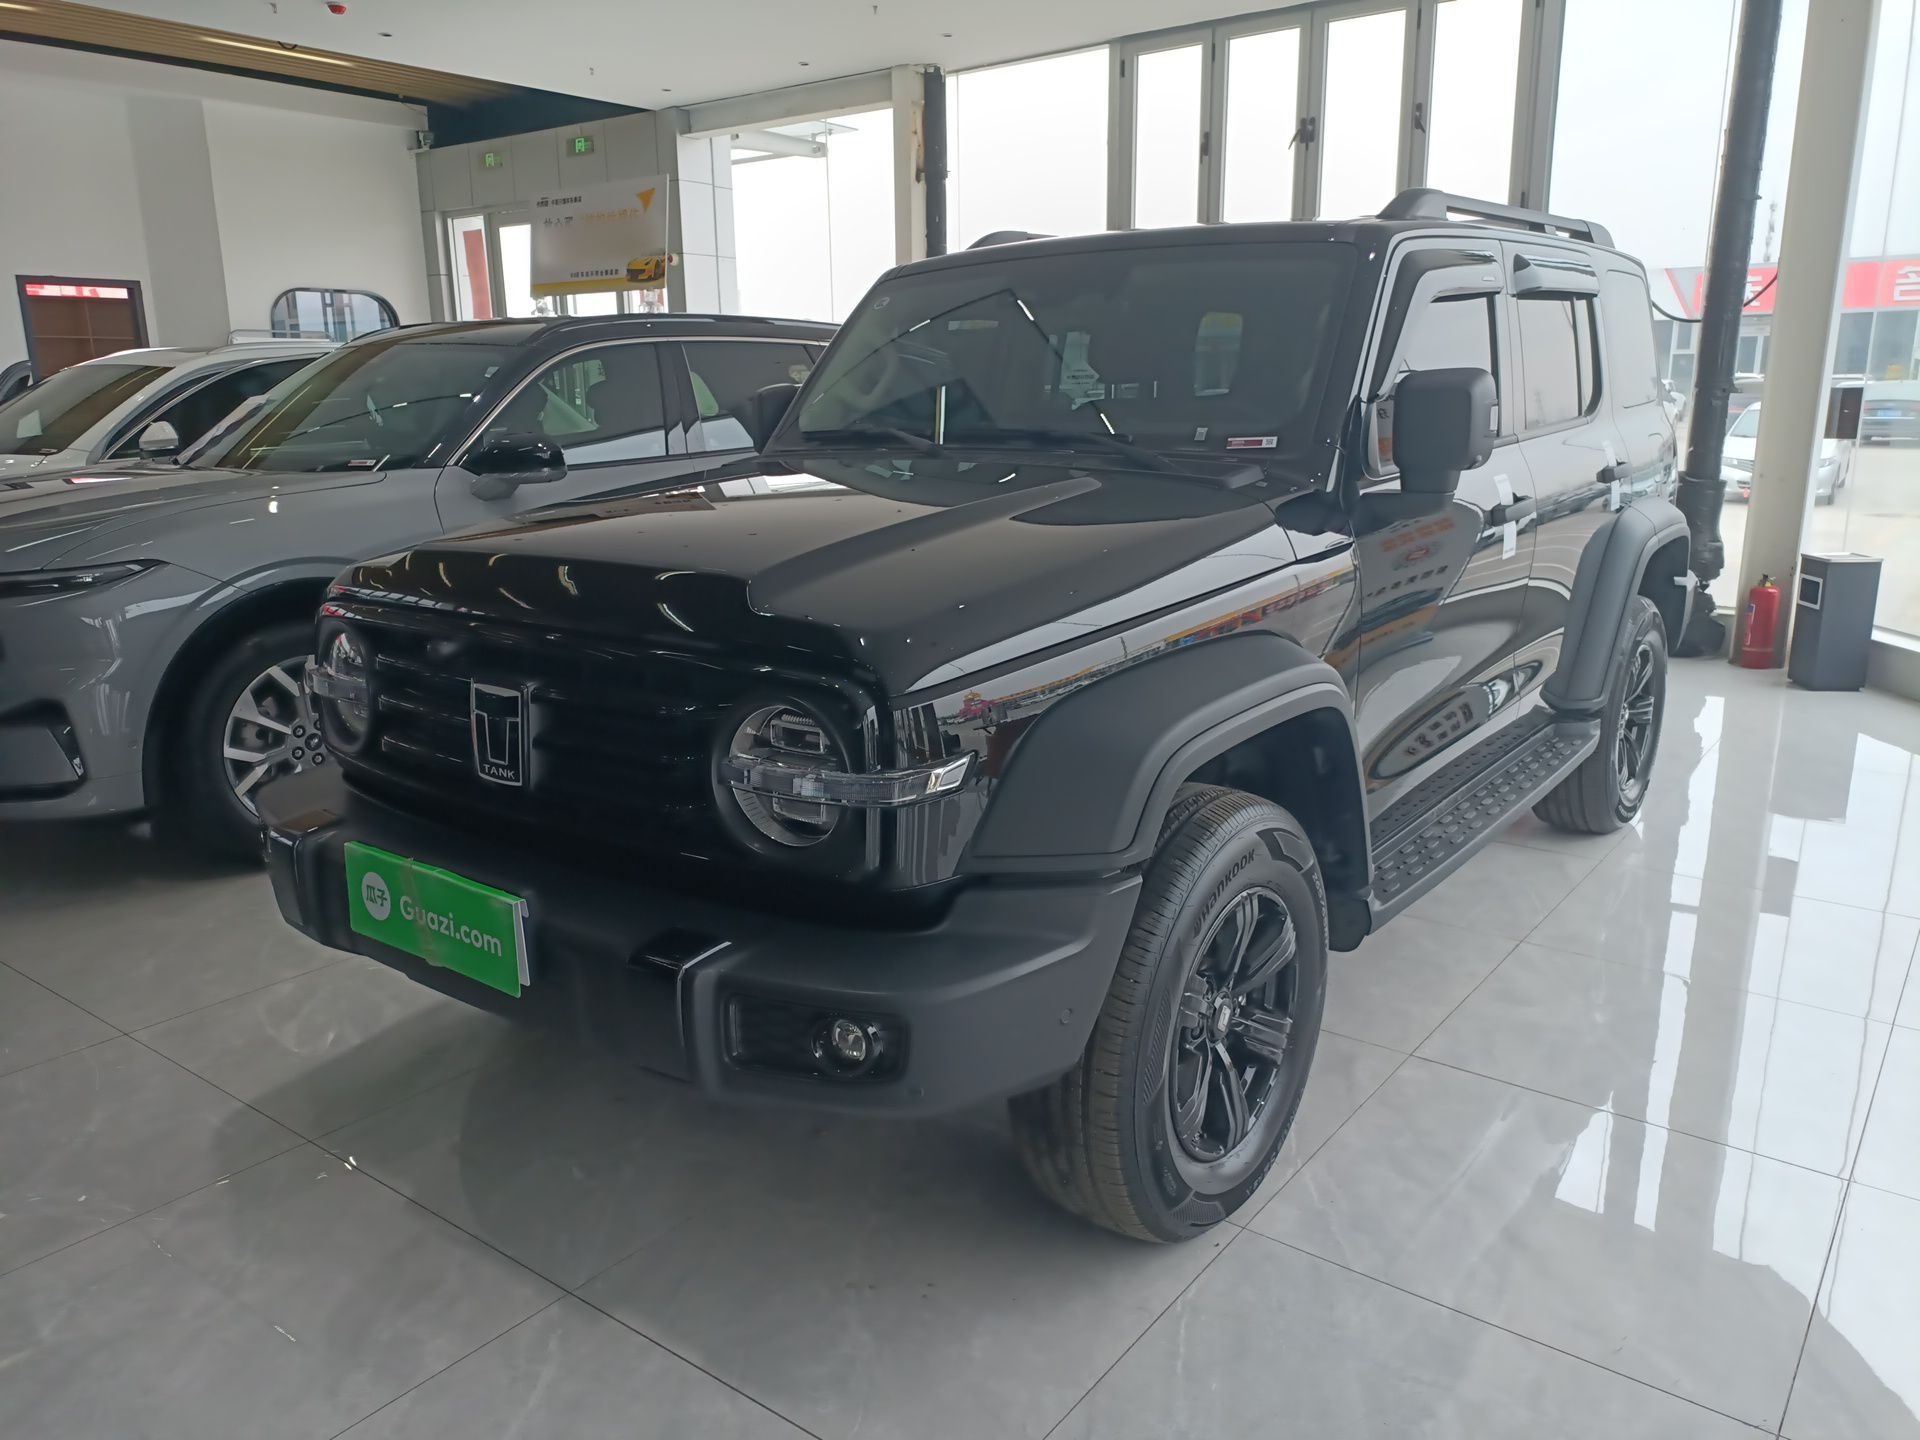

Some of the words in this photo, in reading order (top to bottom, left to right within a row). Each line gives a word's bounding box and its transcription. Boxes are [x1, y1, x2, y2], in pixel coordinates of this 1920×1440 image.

[482, 763, 516, 780] TANK
[365, 884, 388, 907] 瓜子
[399, 895, 503, 957] Guazi.com
